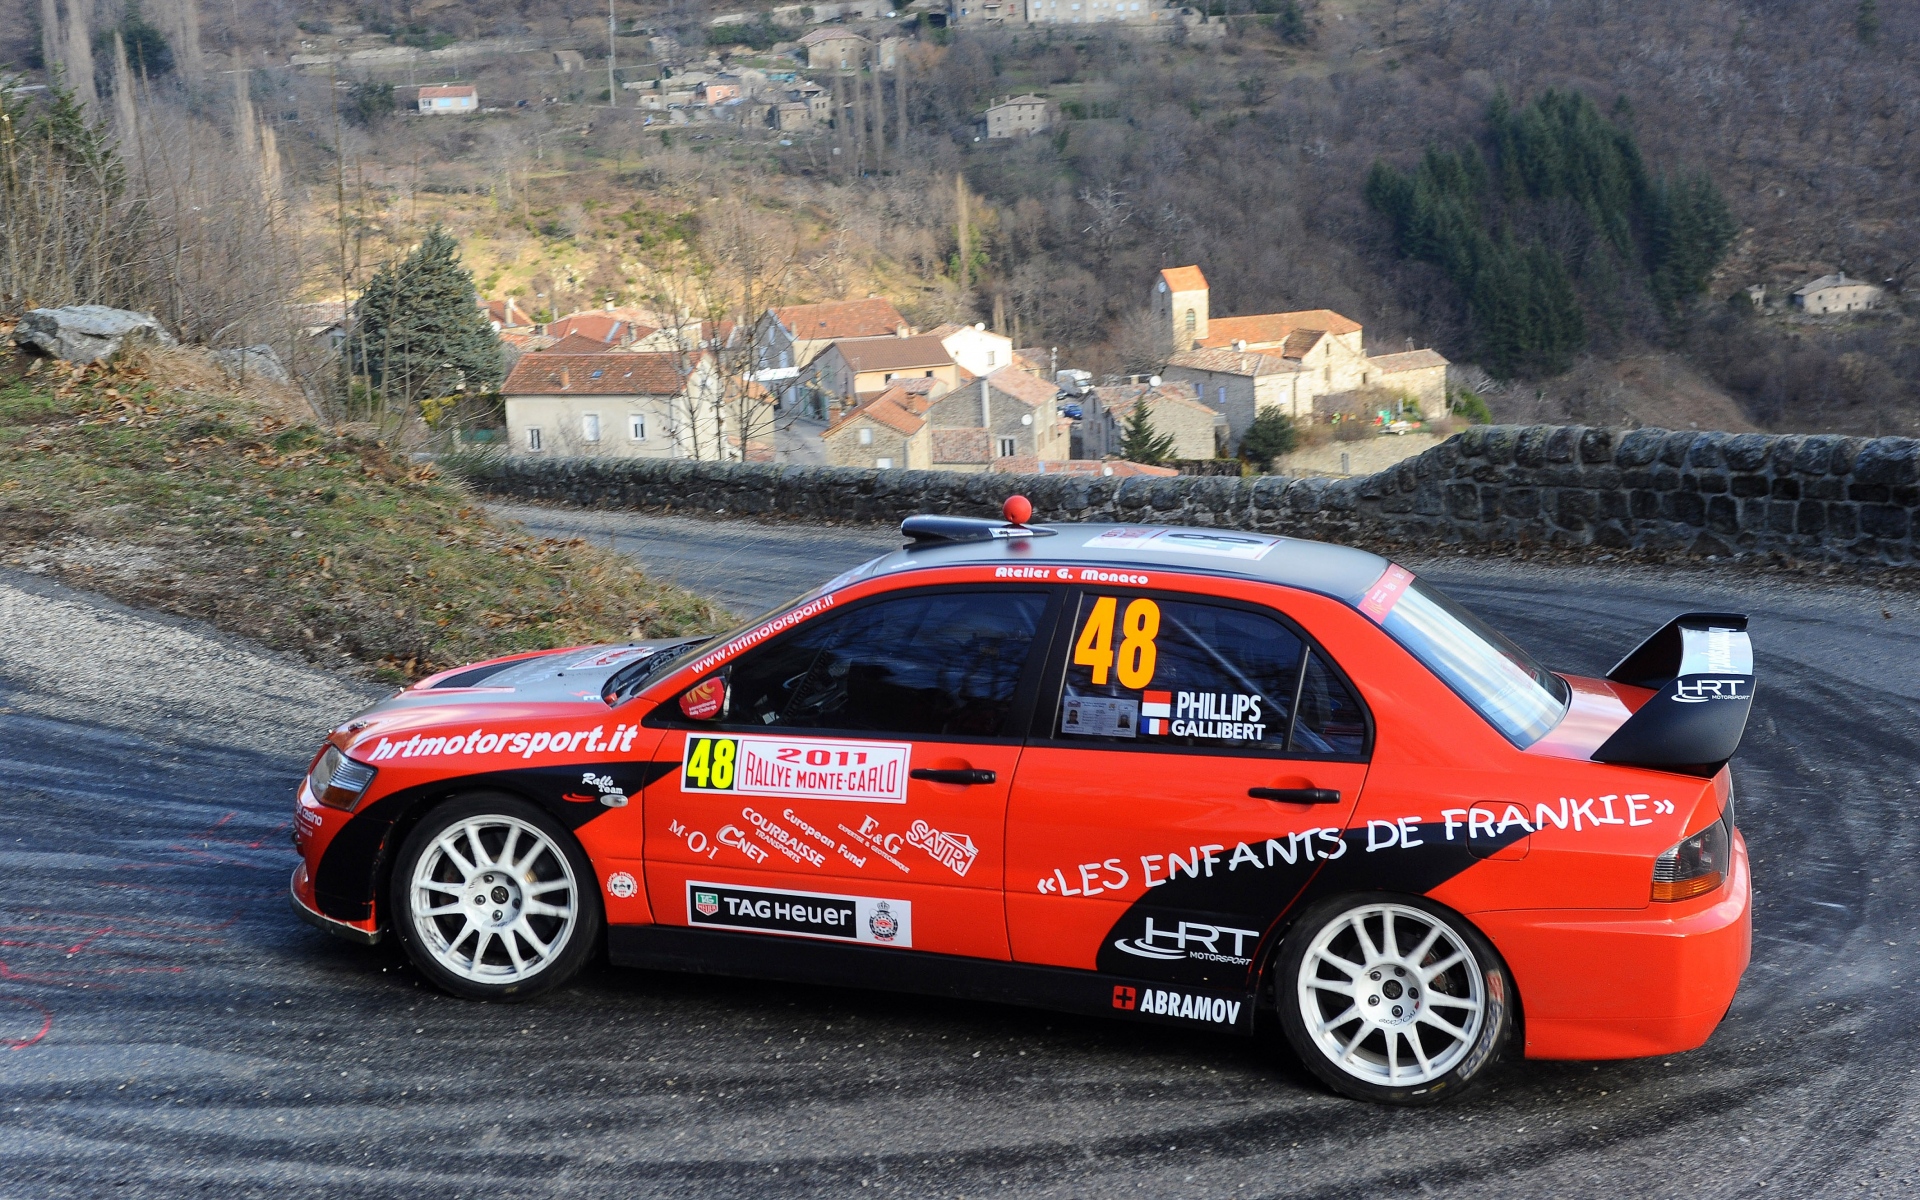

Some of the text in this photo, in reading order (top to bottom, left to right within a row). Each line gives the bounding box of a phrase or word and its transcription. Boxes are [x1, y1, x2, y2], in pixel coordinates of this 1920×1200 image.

[995, 567, 1149, 585] Atelier G. Monaco
[691, 594, 834, 674] www.hrtmotorsport.it
[1073, 596, 1161, 690] 48
[1677, 680, 1745, 696] HRT
[1176, 690, 1262, 723] PHILLIPS
[367, 723, 638, 762] hrtmotorsport.it
[1171, 718, 1266, 741] GALLIBERT
[686, 738, 736, 790] 48
[744, 750, 791, 788] RALLYE
[776, 748, 868, 767] 2011
[597, 784, 624, 795] Team
[741, 806, 826, 868] COURBAISSE
[755, 828, 802, 864] TRANSPORTS
[1139, 827, 1347, 888] ENFANTS
[1365, 816, 1424, 853] DE
[837, 843, 867, 869] Fund
[1145, 917, 1260, 956] HRT
[1189, 951, 1253, 966] MOTORSPORT
[1139, 988, 1241, 1025] ABRAMOV
